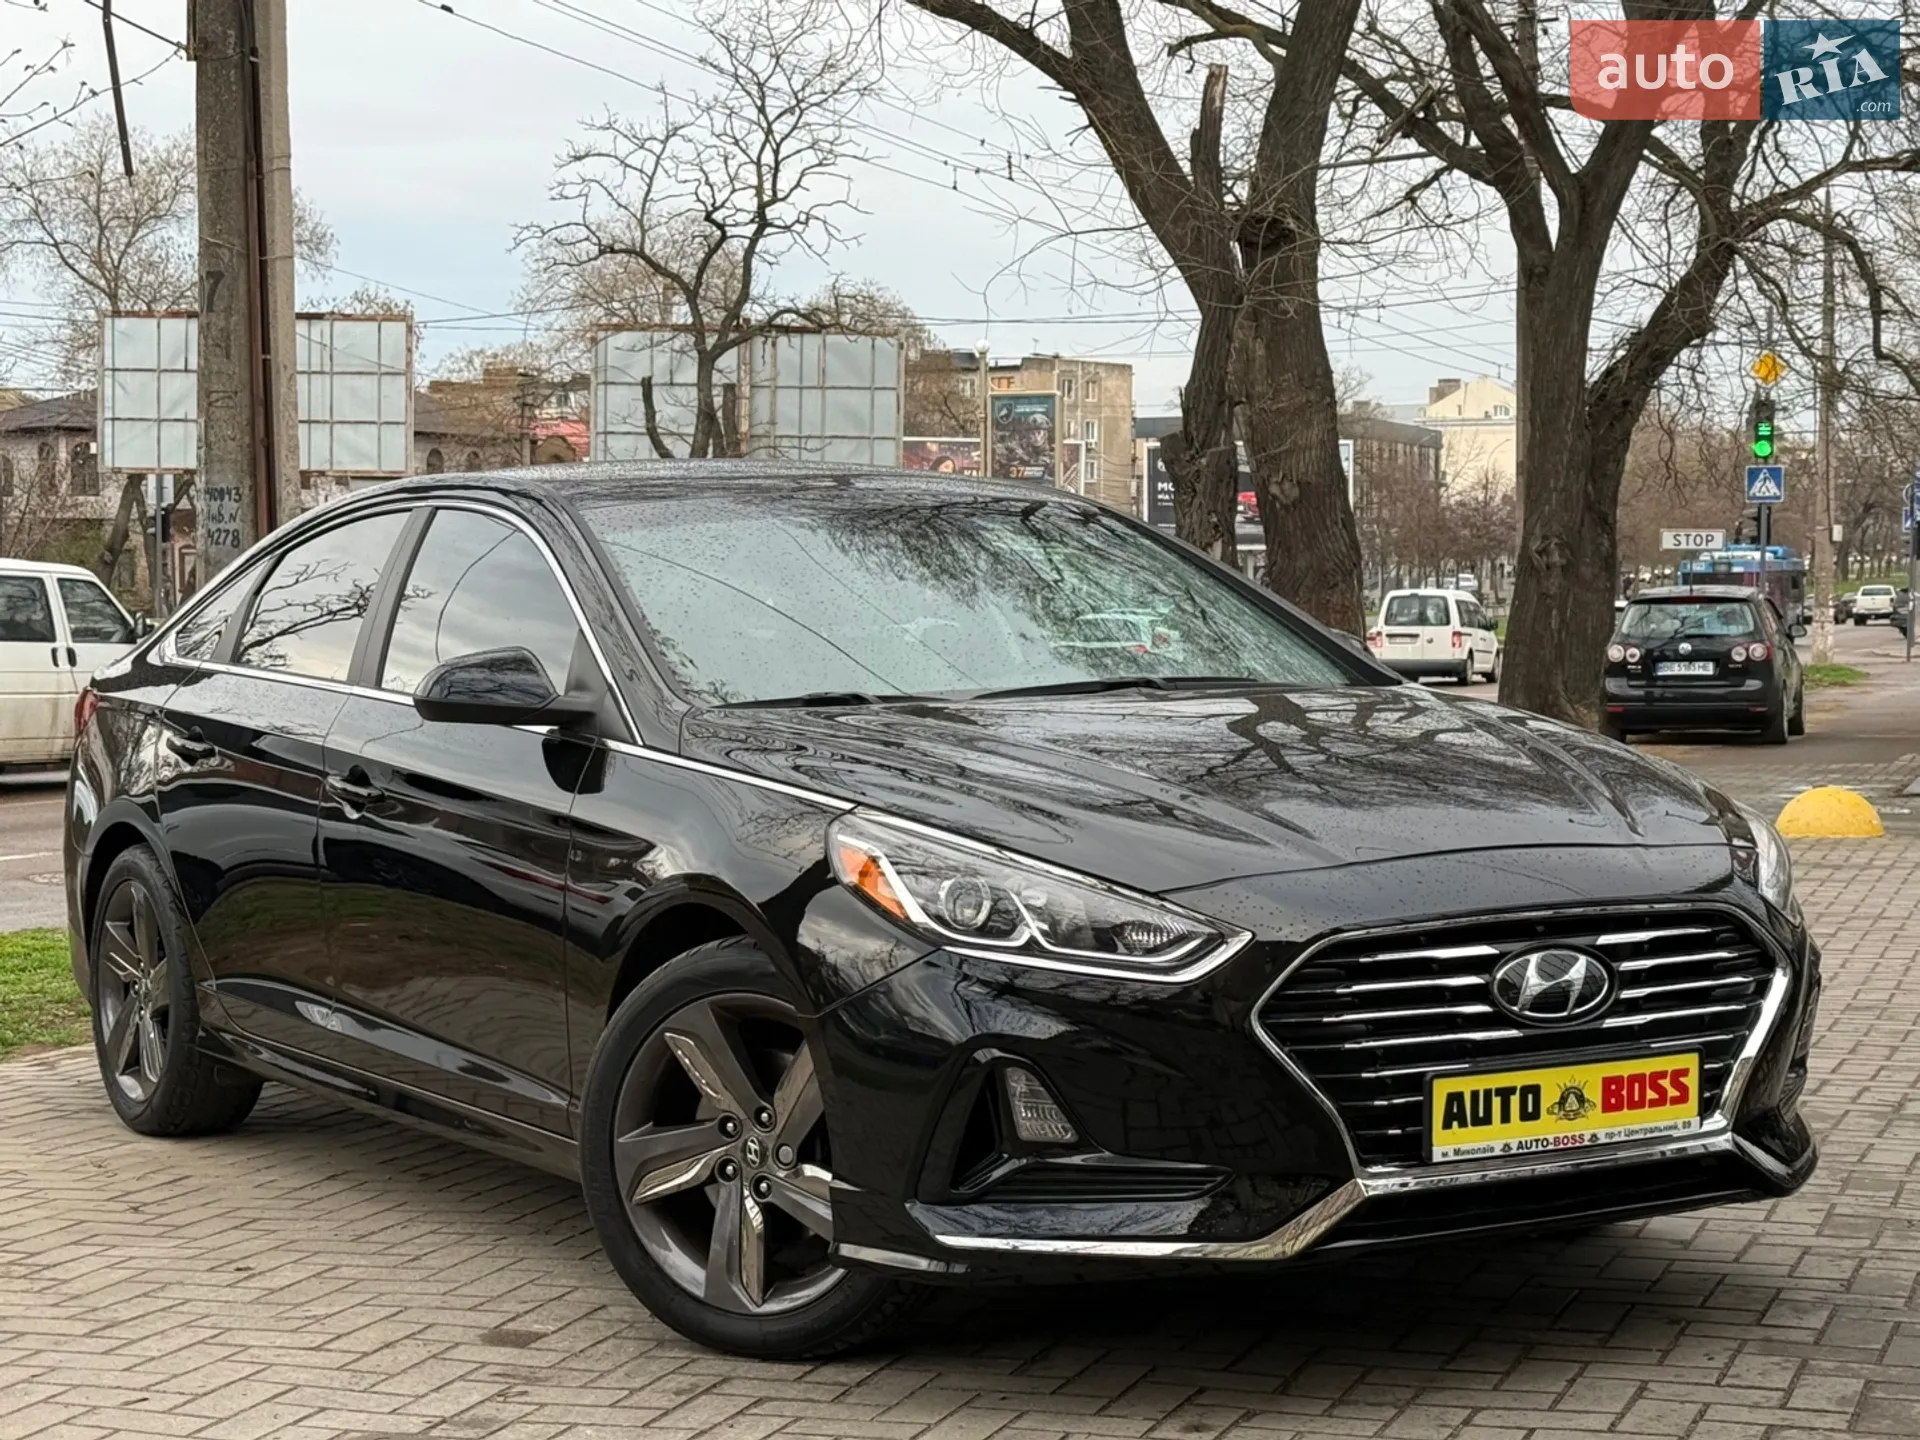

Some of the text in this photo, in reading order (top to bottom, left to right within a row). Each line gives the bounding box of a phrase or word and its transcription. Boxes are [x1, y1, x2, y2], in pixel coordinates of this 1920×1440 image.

[207, 528, 241, 549] 4278
[1673, 534, 1715, 547] STOP
[1441, 1084, 1542, 1131] AUTO
[1601, 1067, 1690, 1114] BOSS
[1453, 1144, 1495, 1157] Миколаїв
[1516, 1133, 1585, 1151] AUTO-BOSS
[1604, 1130, 1622, 1140] пр-т
[1623, 1121, 1680, 1138] Центральний,
[1682, 1120, 1692, 1130] 89
